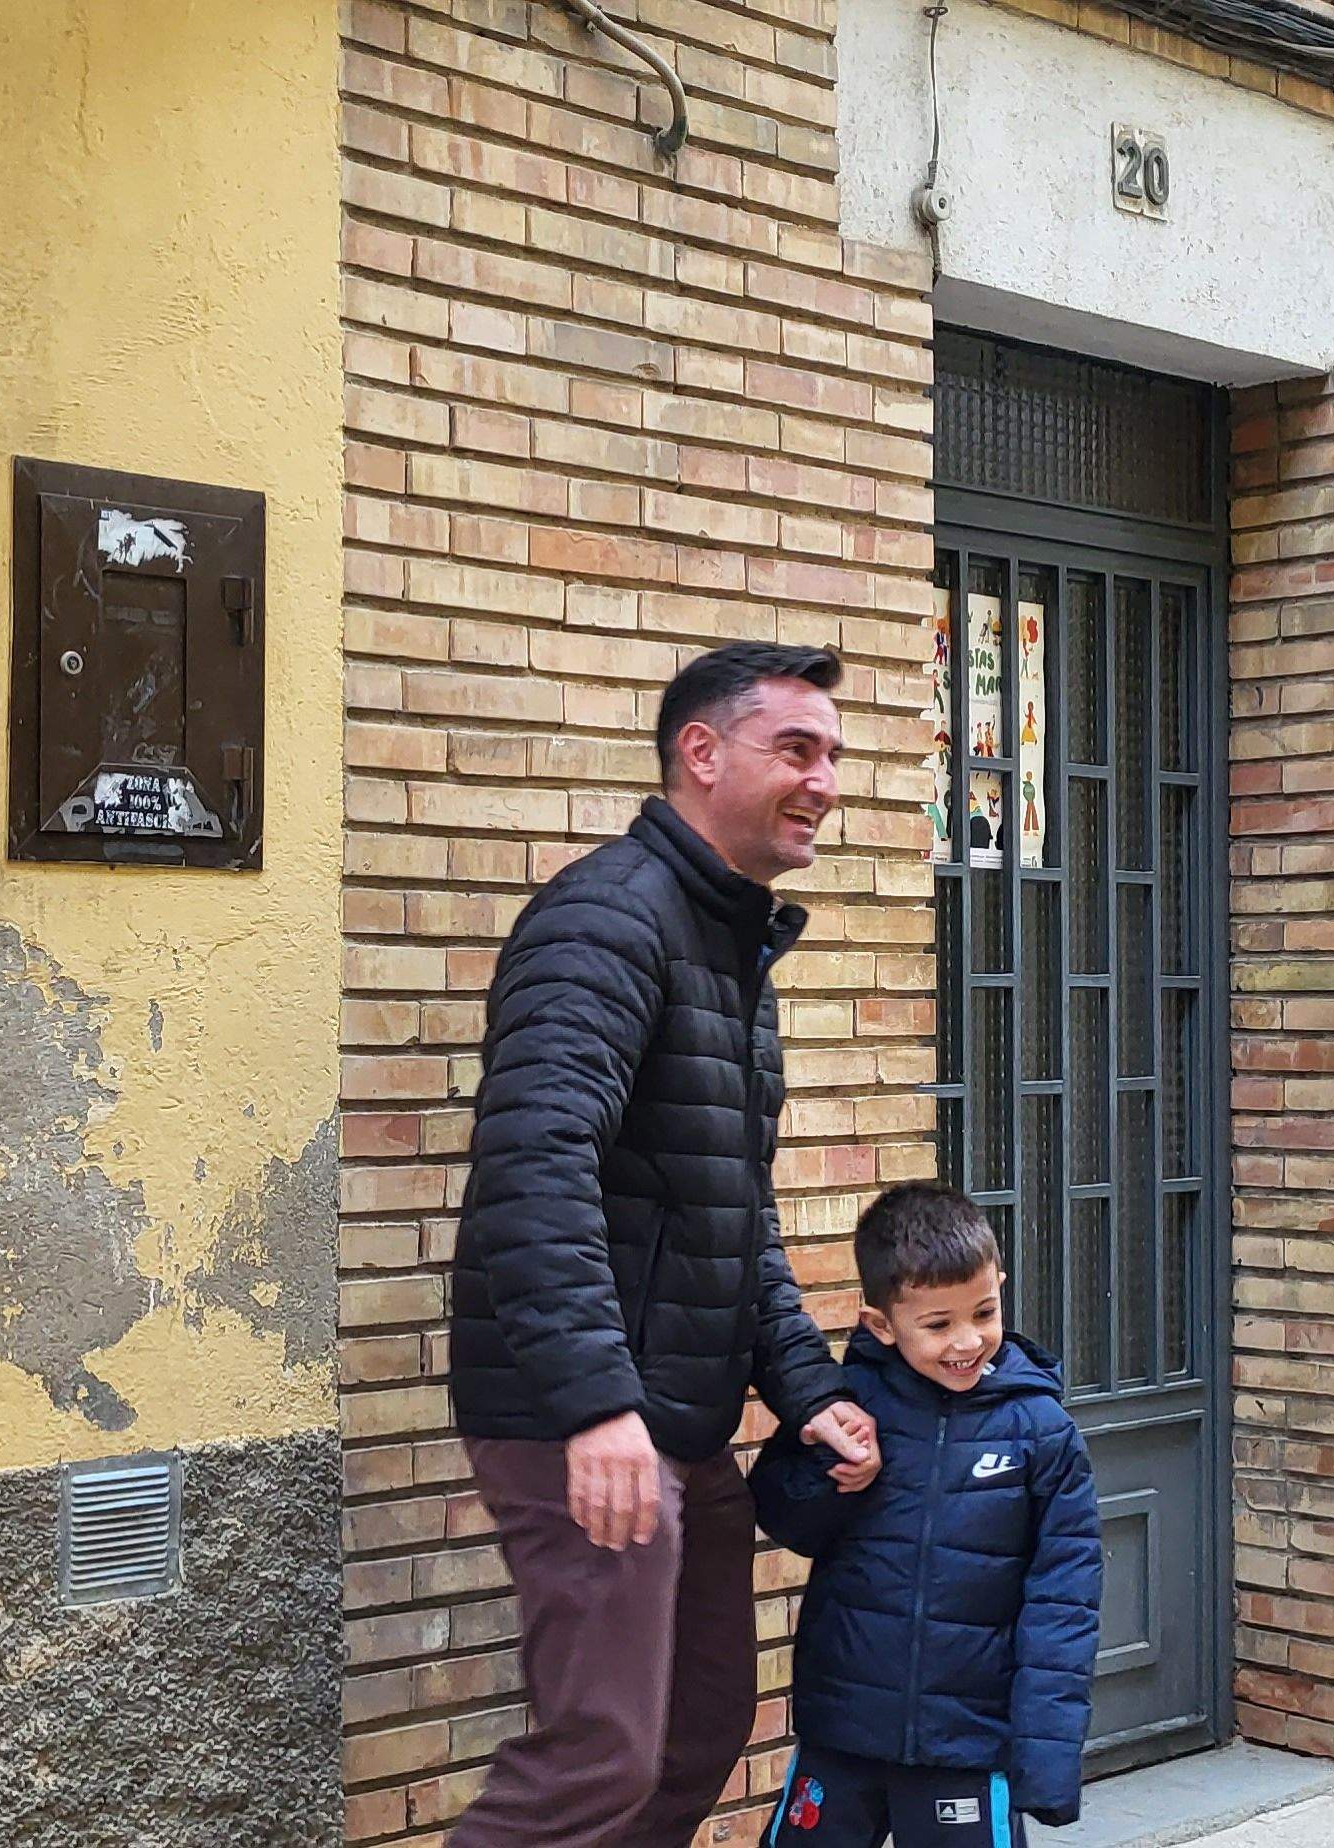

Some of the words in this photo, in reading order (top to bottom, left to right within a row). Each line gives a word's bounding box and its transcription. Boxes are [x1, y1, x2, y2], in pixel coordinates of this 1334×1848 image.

[1116, 138, 1169, 206] 20
[968, 648, 995, 671] STAS
[126, 775, 161, 793] ZONA
[128, 794, 162, 811] 100%
